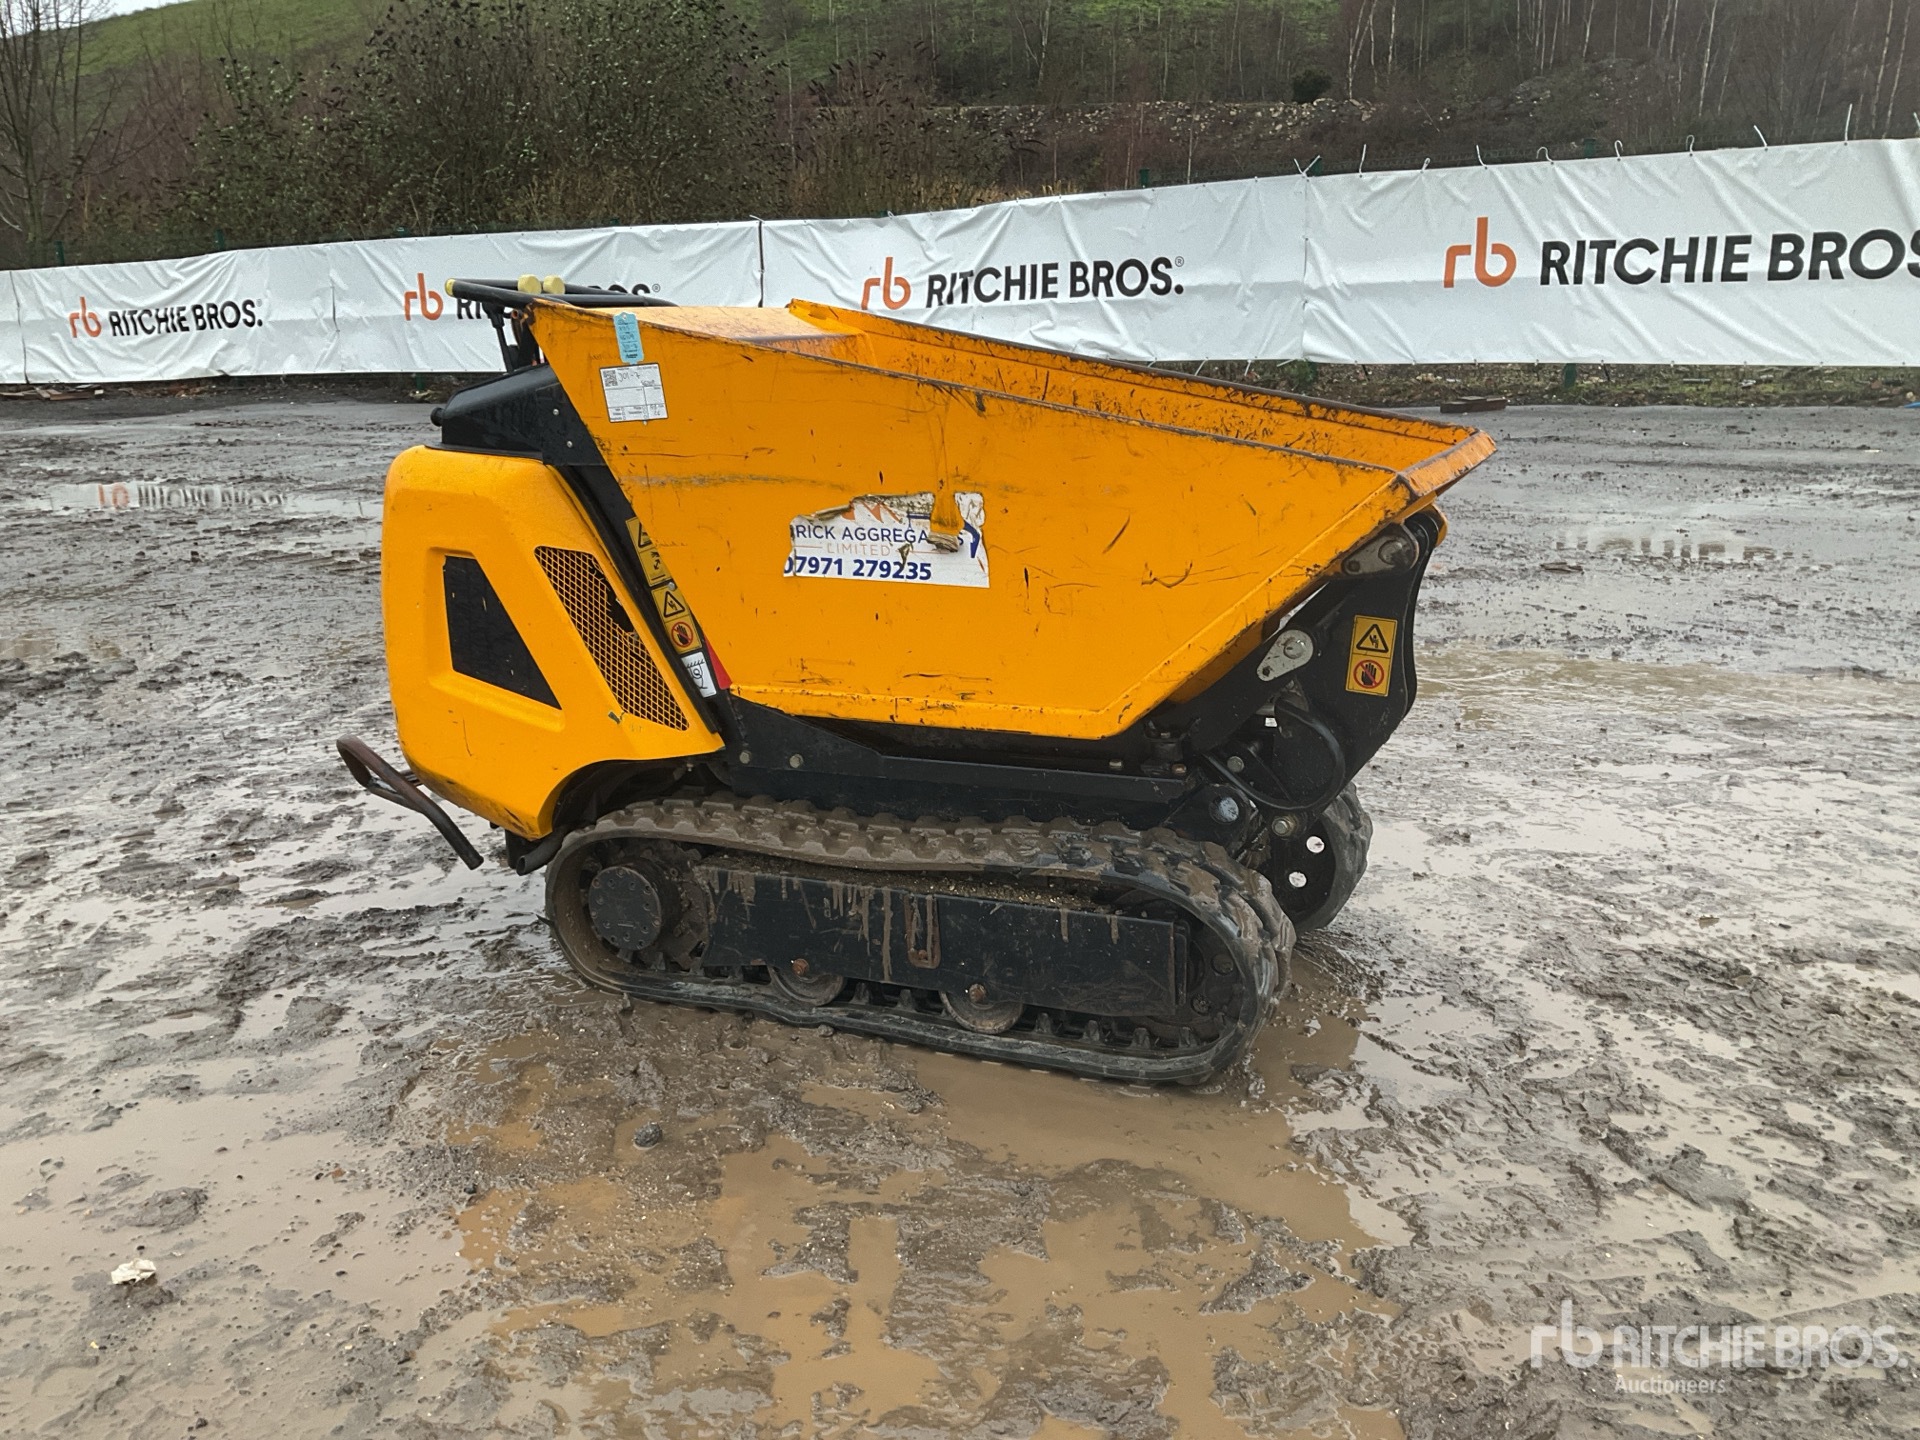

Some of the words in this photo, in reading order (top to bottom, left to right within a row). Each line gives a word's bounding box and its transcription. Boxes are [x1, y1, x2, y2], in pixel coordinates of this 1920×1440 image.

[1443, 217, 1517, 288] rb
[1540, 235, 1752, 286] RITCHIE
[1767, 229, 1920, 282] BRO
[404, 273, 444, 321] rb
[861, 256, 912, 310] rb
[926, 261, 1059, 308] RITCHIE
[69, 296, 102, 338] rb
[109, 306, 189, 336] RITCHIE
[826, 543, 891, 557] LIMITED
[842, 526, 964, 546] AGGREGAS
[784, 556, 843, 576] 07971
[853, 558, 932, 580] 279235
